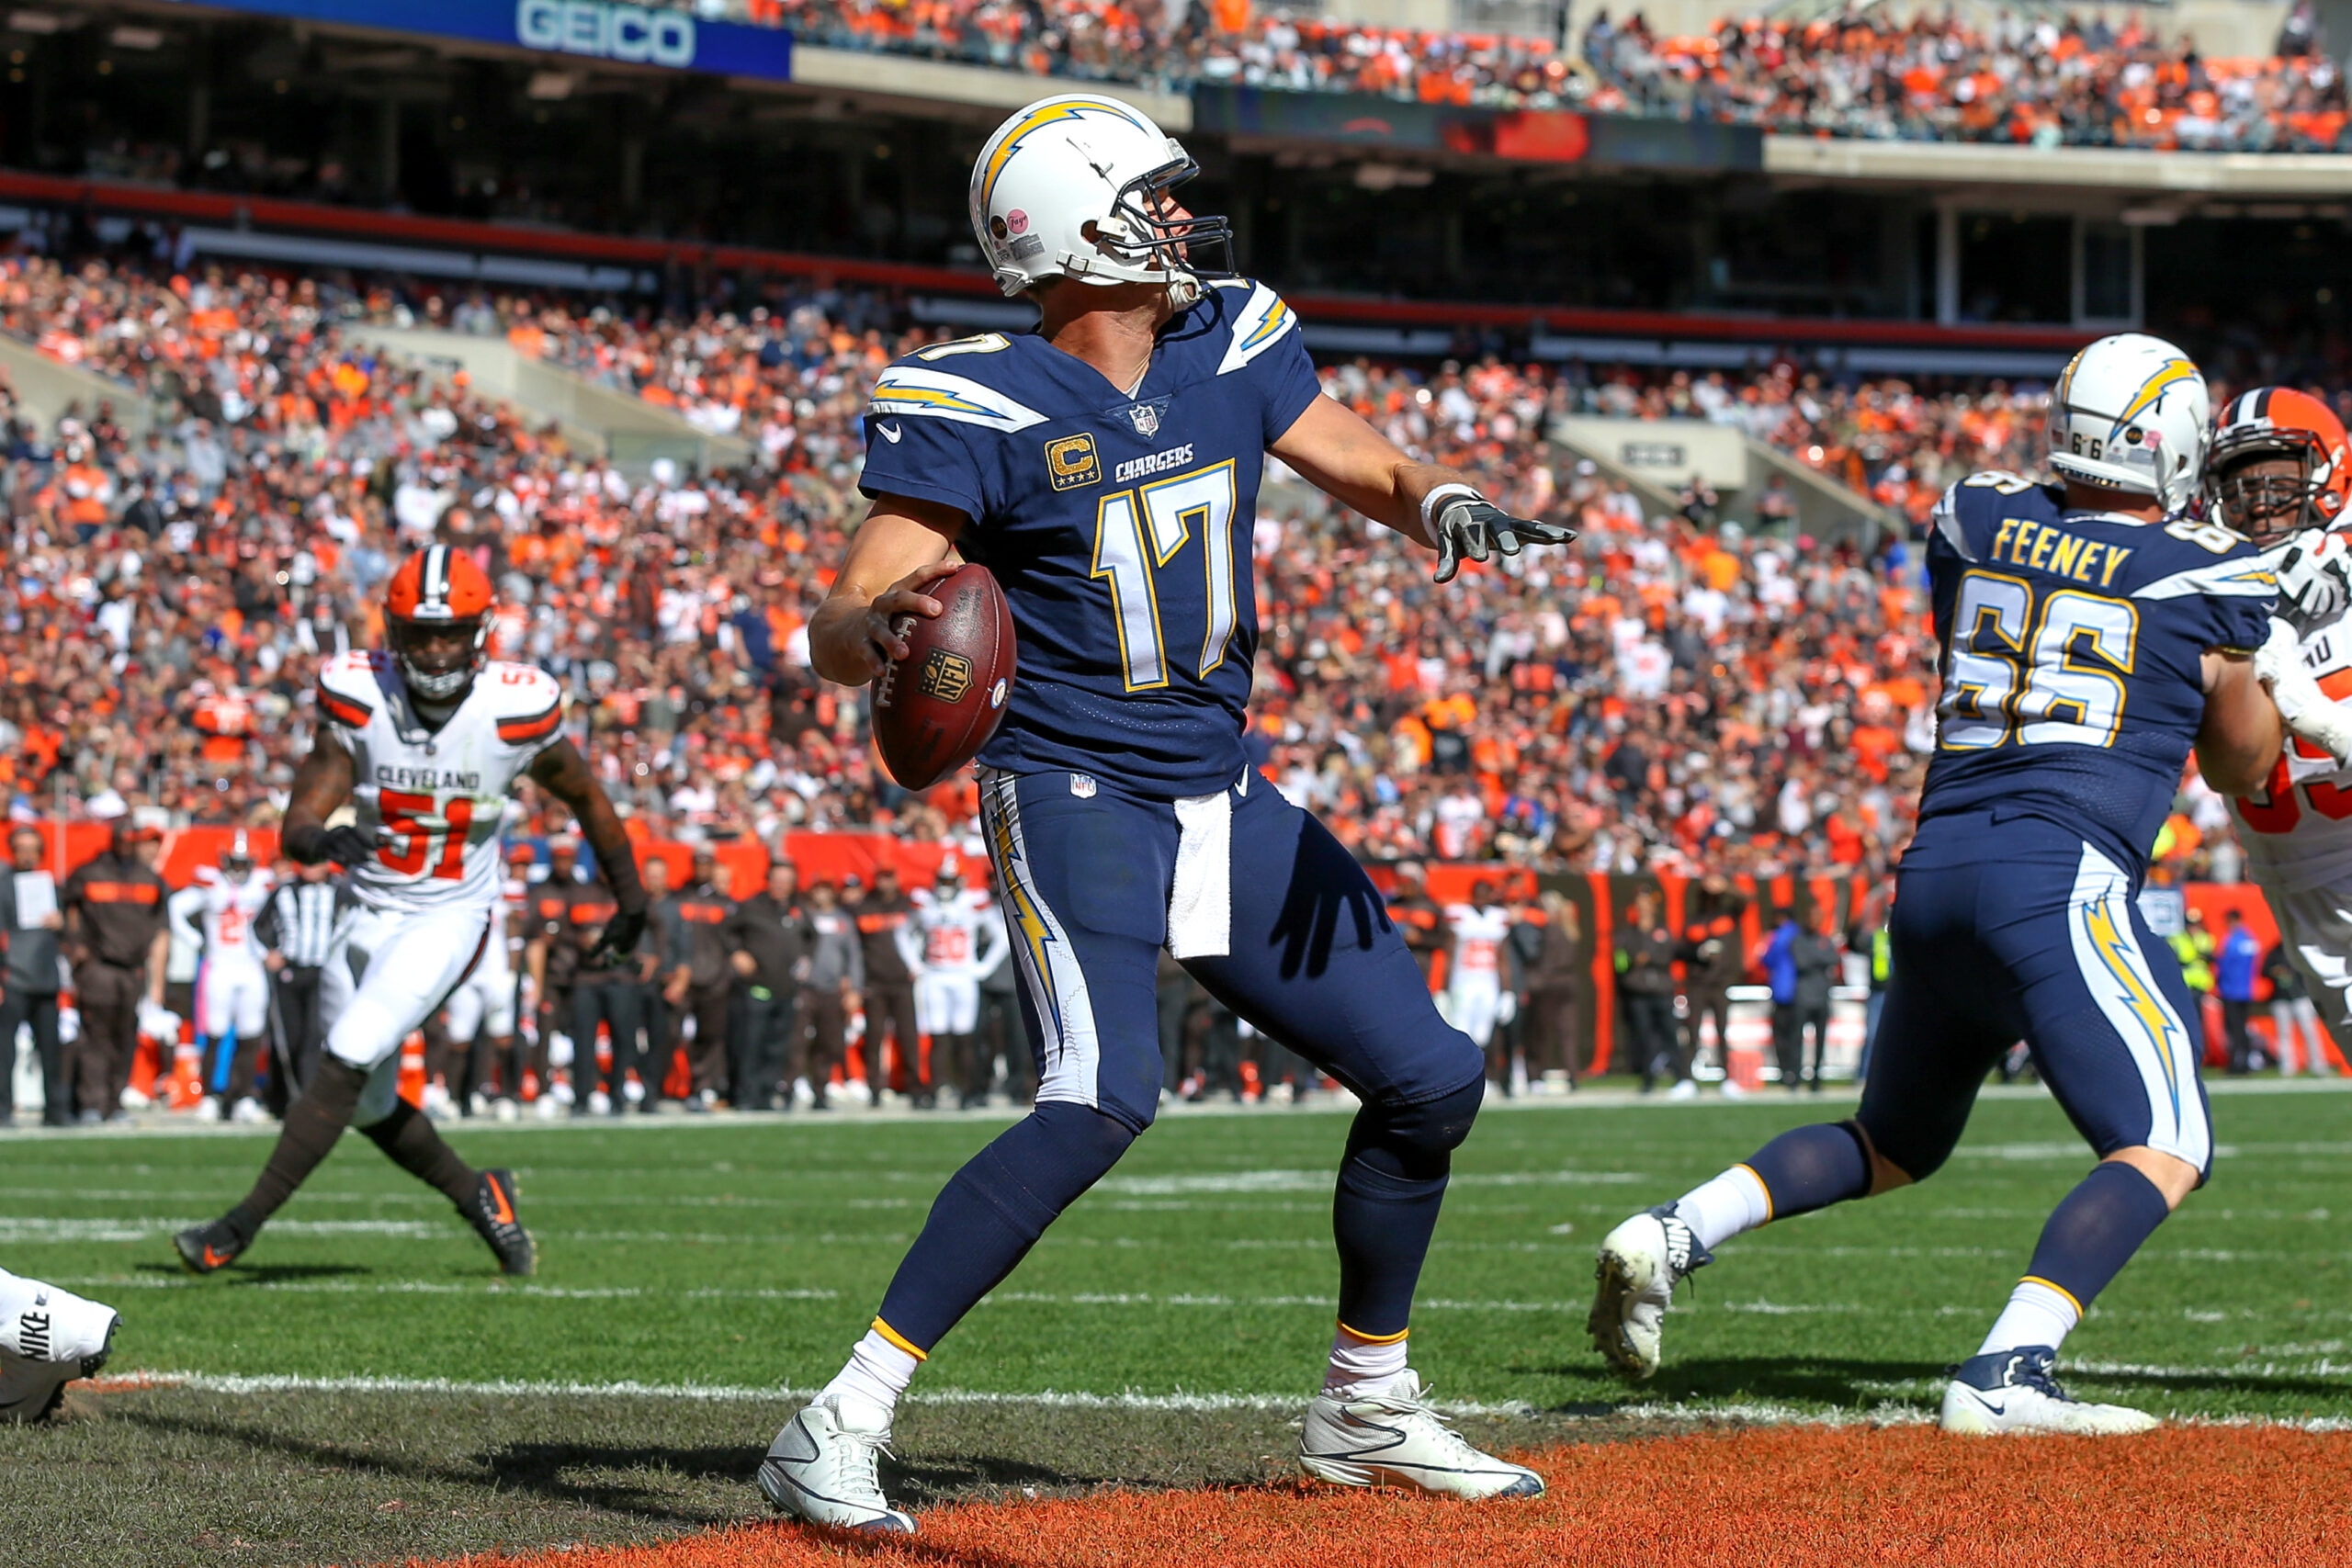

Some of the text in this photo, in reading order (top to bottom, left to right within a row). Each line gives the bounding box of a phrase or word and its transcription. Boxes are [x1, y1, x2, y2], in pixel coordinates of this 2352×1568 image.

[516, 0, 696, 68] GEICO
[1050, 438, 1094, 477] C
[1114, 443, 1194, 483] CHARGERS
[1091, 457, 1238, 693] 17
[1990, 518, 2134, 588] FEENEY
[935, 659, 967, 699] NFL
[1939, 569, 2140, 750] 66
[376, 764, 481, 790] CLEVELAND
[375, 788, 475, 881] 51
[1662, 1217, 1690, 1269] NIKE
[19, 1311, 51, 1360] NIKE
